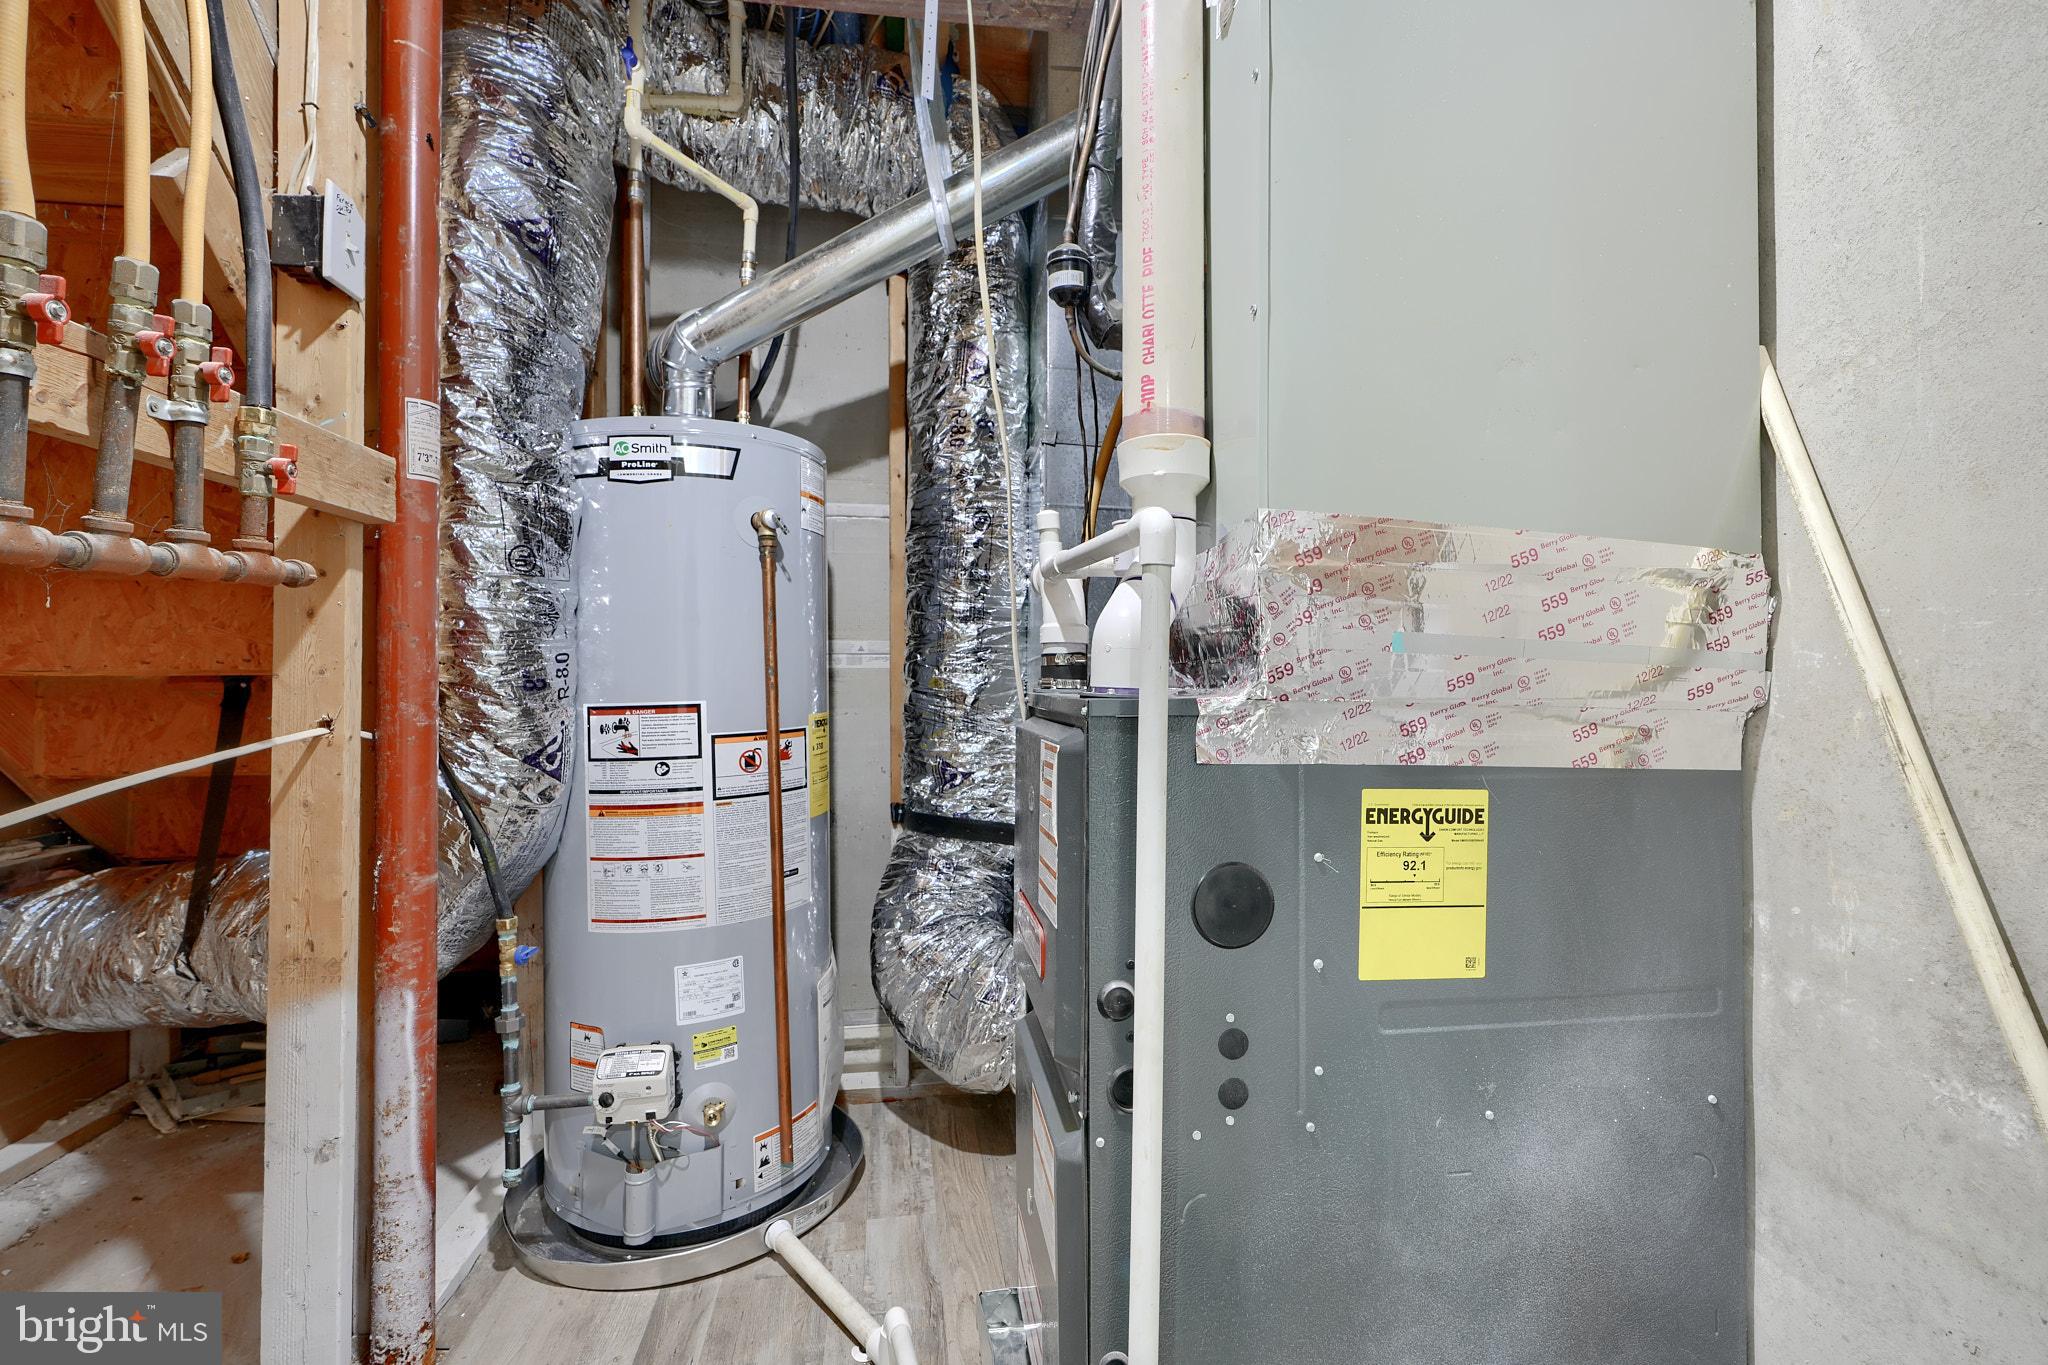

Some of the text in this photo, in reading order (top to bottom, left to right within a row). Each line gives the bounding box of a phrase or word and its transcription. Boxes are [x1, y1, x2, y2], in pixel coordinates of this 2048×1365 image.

[631, 443, 667, 454] Smith
[1294, 546, 1323, 567] 559
[1376, 544, 1398, 557] Global
[1510, 547, 1539, 568] 559
[1540, 539, 1558, 550] Berry
[1555, 562, 1578, 574] Global
[1484, 573, 1514, 592] 12/22
[1541, 591, 1569, 613] 559
[1569, 582, 1588, 593] Berry
[1585, 590, 1597, 598] Inc.
[1331, 607, 1345, 616] Inc.
[1481, 604, 1512, 624] 12/22
[1567, 604, 1606, 625] Berry Global
[1707, 605, 1733, 626] 559
[1537, 622, 1566, 641] 559
[1731, 618, 1767, 637] Berry Global
[1705, 635, 1730, 652] 559
[555, 652, 570, 700] R-8.0
[1266, 652, 1315, 684] 559 Berry
[1446, 672, 1475, 693] 559
[1477, 662, 1496, 673] Berry
[1492, 668, 1505, 677] Inc.
[1636, 665, 1665, 685] 12/22
[1292, 674, 1334, 695] Berry Global
[1307, 690, 1321, 698] Inc.
[1471, 684, 1513, 703] Berry Global
[1687, 682, 1714, 701] 559
[1341, 701, 1373, 721] 12/22
[1706, 701, 1725, 711] Berry
[1727, 694, 1749, 705] Global
[1399, 716, 1427, 738] 559
[1429, 706, 1448, 718] Berry
[1444, 713, 1457, 721] Inc.
[1614, 719, 1627, 727] Inc.
[1339, 731, 1370, 752] 12/22
[1427, 727, 1466, 749] Berry Global
[1572, 722, 1599, 743] 559
[1442, 744, 1455, 752] Inc.
[1613, 748, 1625, 756] Inc.
[1572, 752, 1598, 769] 559
[1366, 808, 1484, 824] ENERGYGUIDE
[1403, 861, 1426, 871] 92.1
